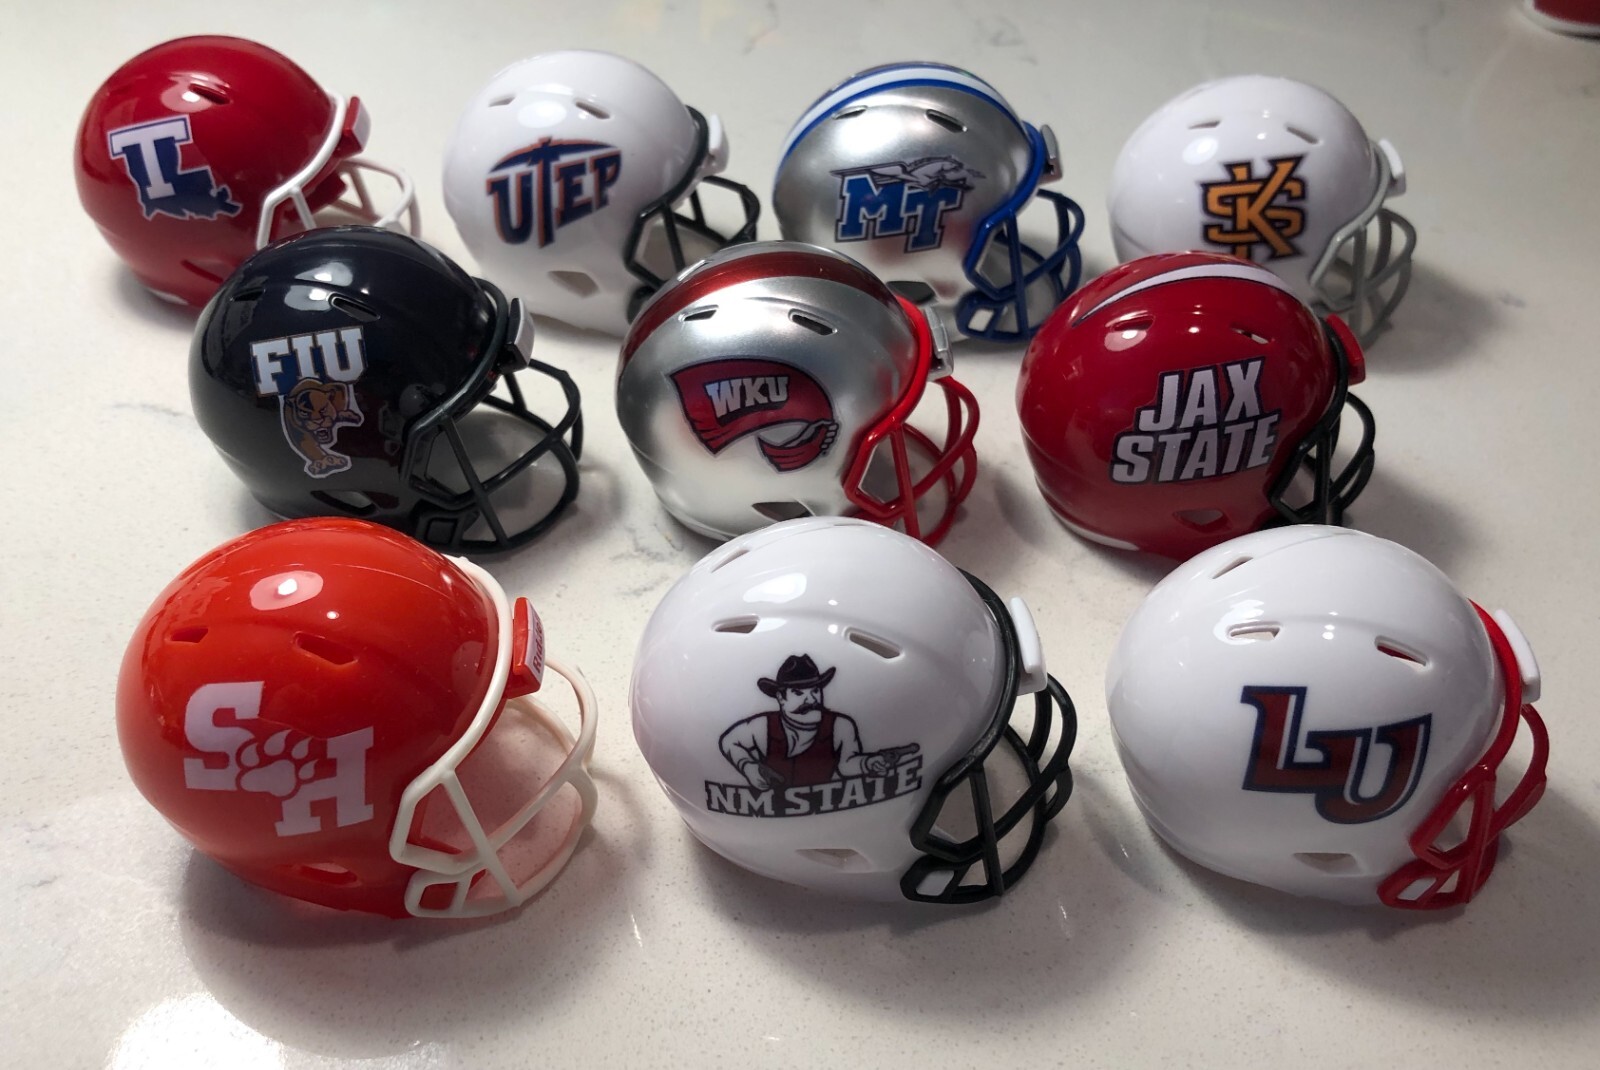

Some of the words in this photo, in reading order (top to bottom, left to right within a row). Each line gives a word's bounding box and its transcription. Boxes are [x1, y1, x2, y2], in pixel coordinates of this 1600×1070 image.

[486, 136, 622, 248] UTEP
[835, 171, 965, 254] MT
[250, 326, 368, 398] FIU
[704, 375, 790, 421] WKU
[1136, 357, 1265, 432] JAX
[1110, 411, 1281, 484] STATE
[183, 680, 375, 838] SH
[704, 780, 776, 817] NM
[783, 755, 924, 816] STATE
[1240, 685, 1432, 824] LU
